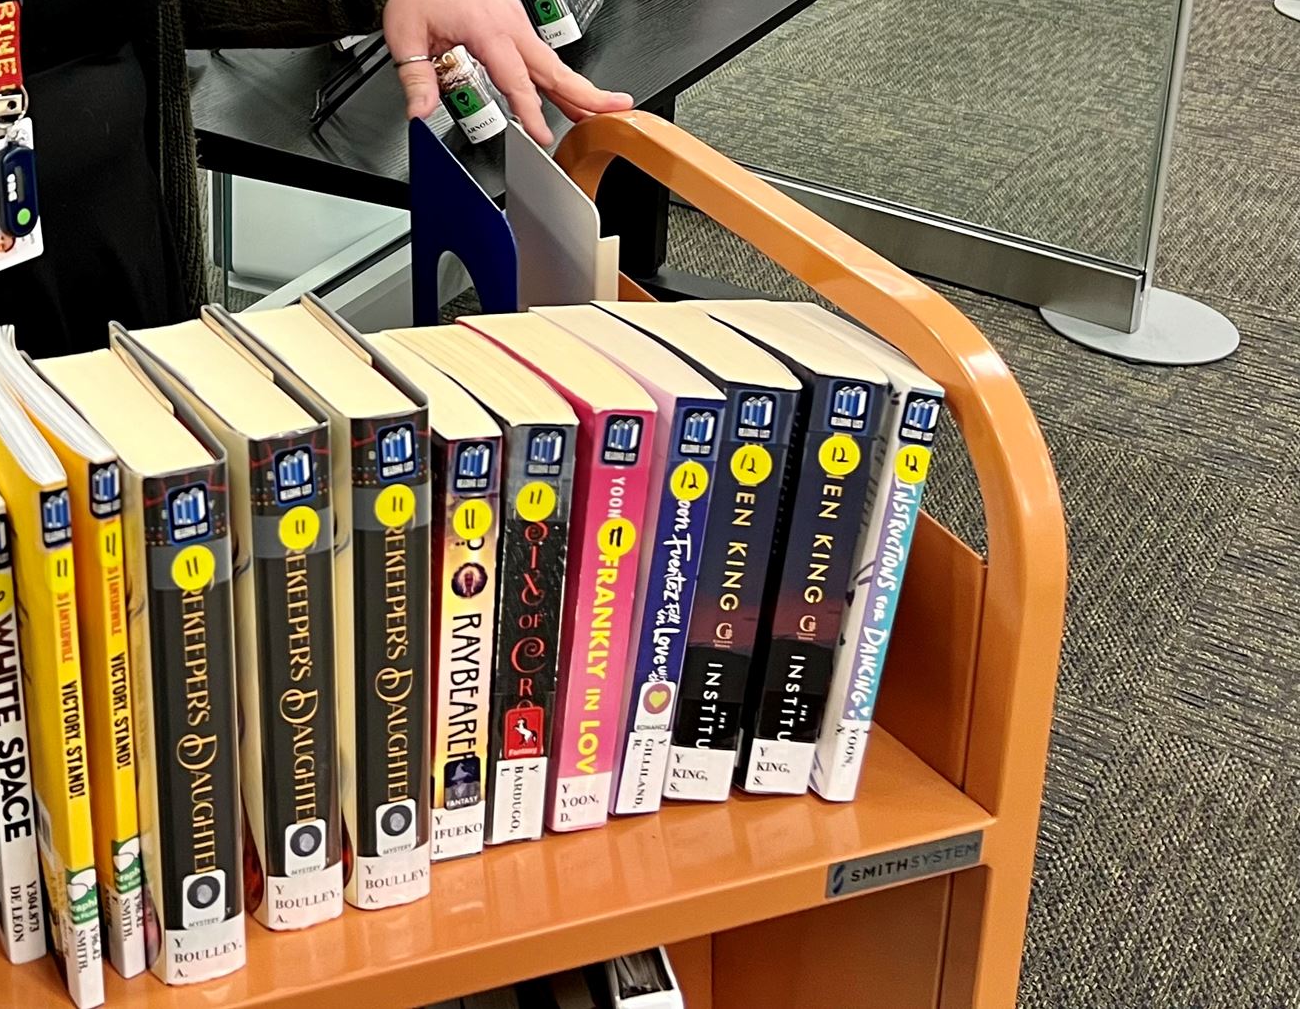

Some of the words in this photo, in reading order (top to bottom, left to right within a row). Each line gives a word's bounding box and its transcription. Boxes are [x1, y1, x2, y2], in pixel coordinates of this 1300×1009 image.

[740, 453, 757, 474] 12
[832, 447, 849, 463] 12
[905, 453, 918, 472] 12
[681, 470, 699, 490] 12
[392, 497, 404, 512] 11
[529, 490, 542, 505] 11
[607, 476, 626, 518] YOON
[295, 520, 306, 534] 11
[465, 509, 475, 530] 11
[106, 533, 117, 556] 11
[877, 479, 916, 592] INSTRUCTIONS
[57, 558, 68, 577] 11
[187, 557, 199, 577] 11
[663, 533, 692, 601] Fuentez
[719, 541, 748, 611] KING
[804, 534, 834, 604] KING
[385, 527, 409, 660] REKEEPER'S
[518, 609, 546, 630] OF
[586, 554, 619, 680] FRANKLY
[653, 627, 681, 665] Love
[182, 590, 212, 726] REKEEPER'S
[851, 626, 888, 708] DANCING
[584, 688, 601, 711] IN
[695, 662, 724, 750] INSTITU
[776, 655, 806, 742] INSTITU
[114, 716, 132, 770] STAND!
[375, 667, 413, 802] DAUGHTE
[280, 689, 318, 823] DAUGHTE
[576, 720, 601, 774] LOV
[674, 753, 684, 764] Y
[759, 747, 769, 757] Y
[66, 745, 86, 800] STAND!
[562, 784, 571, 793] Y
[176, 734, 218, 873] DAUGHTE
[447, 795, 478, 808] FANTASY
[434, 816, 443, 825] Y
[365, 865, 375, 875] Y
[851, 842, 979, 883] SMITHSYSTEM
[10, 885, 21, 903] DE
[275, 885, 285, 895] Y
[26, 880, 41, 933] Y304.873
[174, 938, 184, 949] Y
